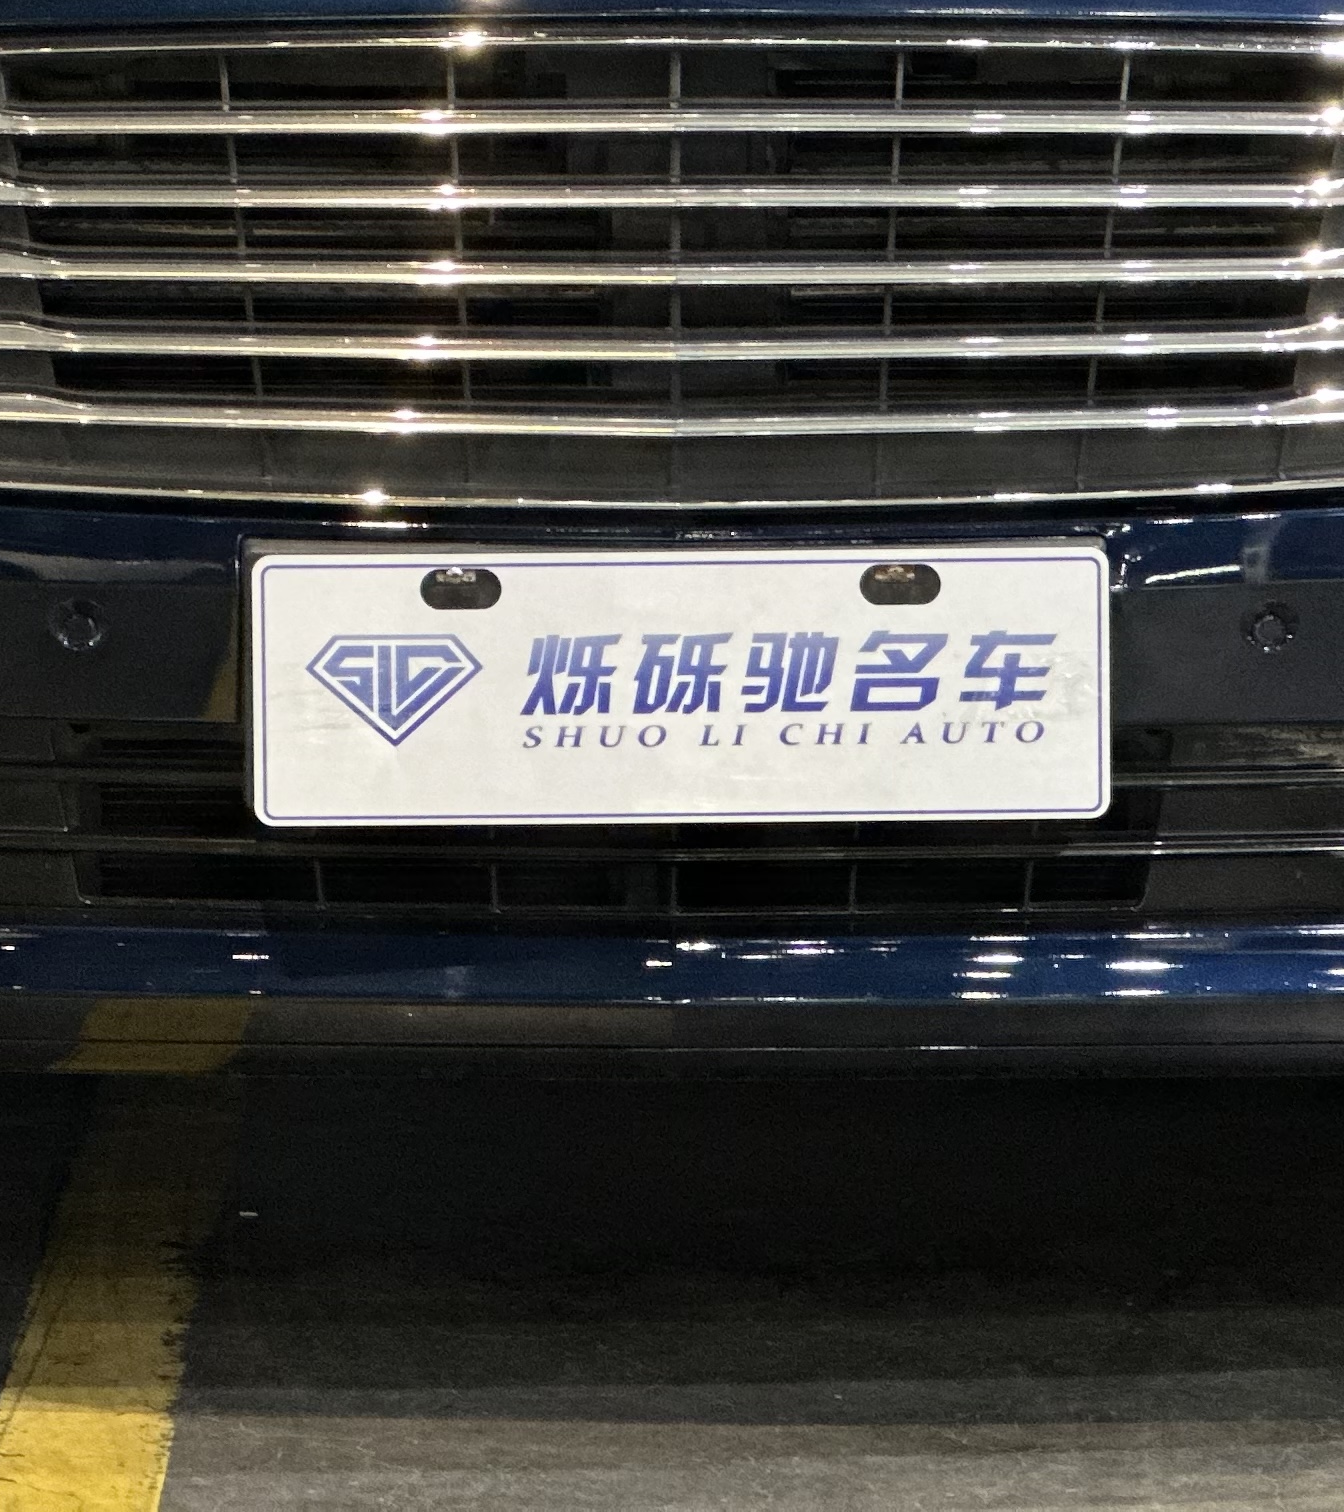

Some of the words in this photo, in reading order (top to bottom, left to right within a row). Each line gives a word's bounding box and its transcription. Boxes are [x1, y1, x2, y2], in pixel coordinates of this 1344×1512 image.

[520, 631, 1057, 715] 烁砾驰名车
[522, 724, 668, 749] SHUO
[698, 723, 748, 747] LI
[779, 722, 873, 746] CHI
[899, 720, 1045, 745] AUTO
